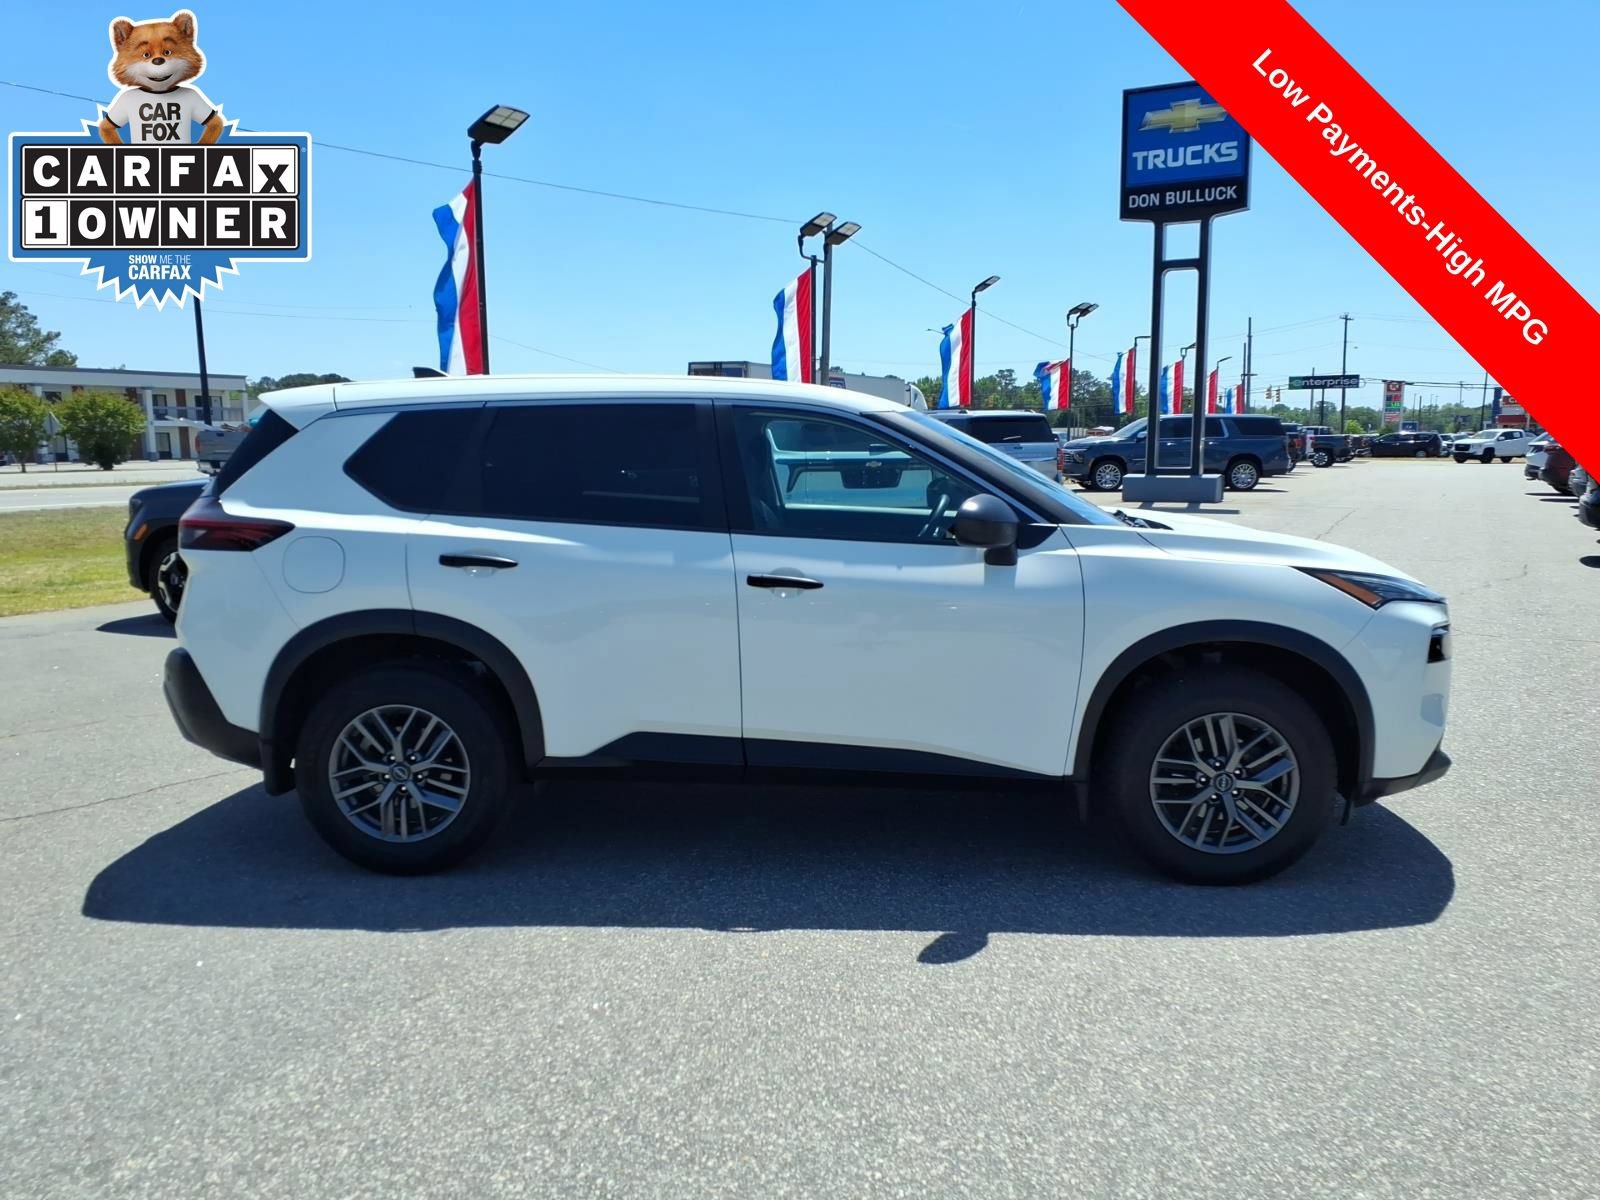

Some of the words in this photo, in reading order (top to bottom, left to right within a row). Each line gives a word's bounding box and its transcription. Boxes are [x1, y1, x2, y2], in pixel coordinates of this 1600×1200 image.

[1132, 141, 1238, 171] TRUCKS
[1128, 193, 1160, 208] DON
[1165, 185, 1238, 205] BULLUCK
[1292, 377, 1358, 387] enterprise
